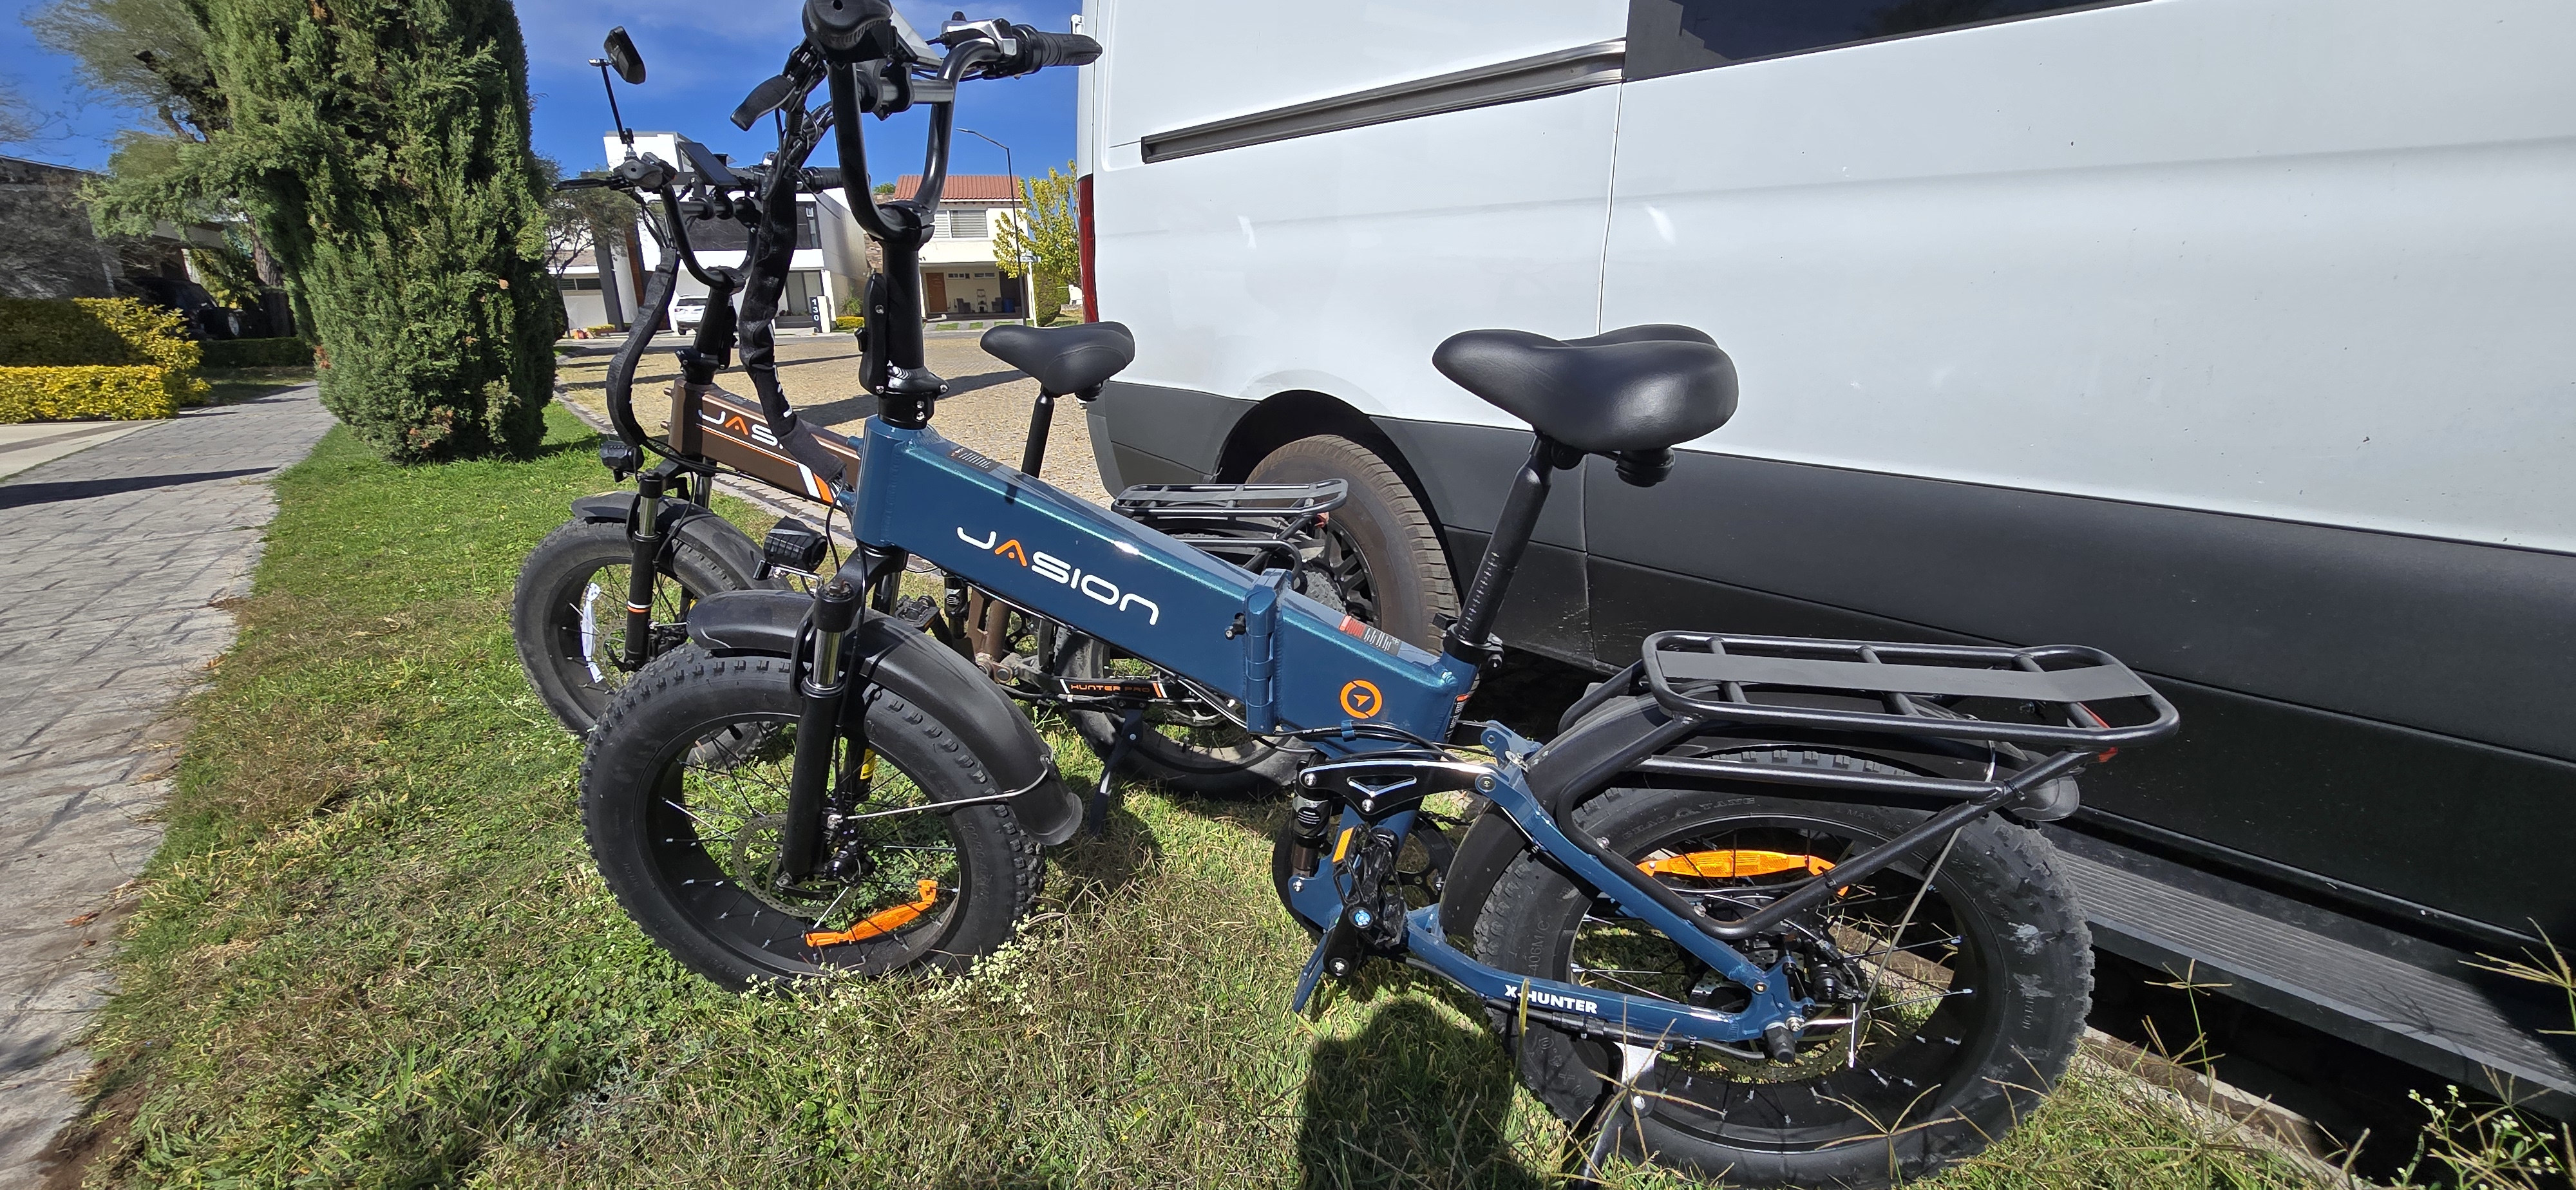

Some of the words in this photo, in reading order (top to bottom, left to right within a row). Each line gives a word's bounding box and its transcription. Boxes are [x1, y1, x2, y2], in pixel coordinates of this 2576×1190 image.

[811, 298, 820, 321] 130
[697, 410, 784, 449] JAS
[956, 526, 1160, 626] JASION
[1070, 683, 1121, 692] HUNTER
[1504, 984, 1598, 1015] X-HUNTER
